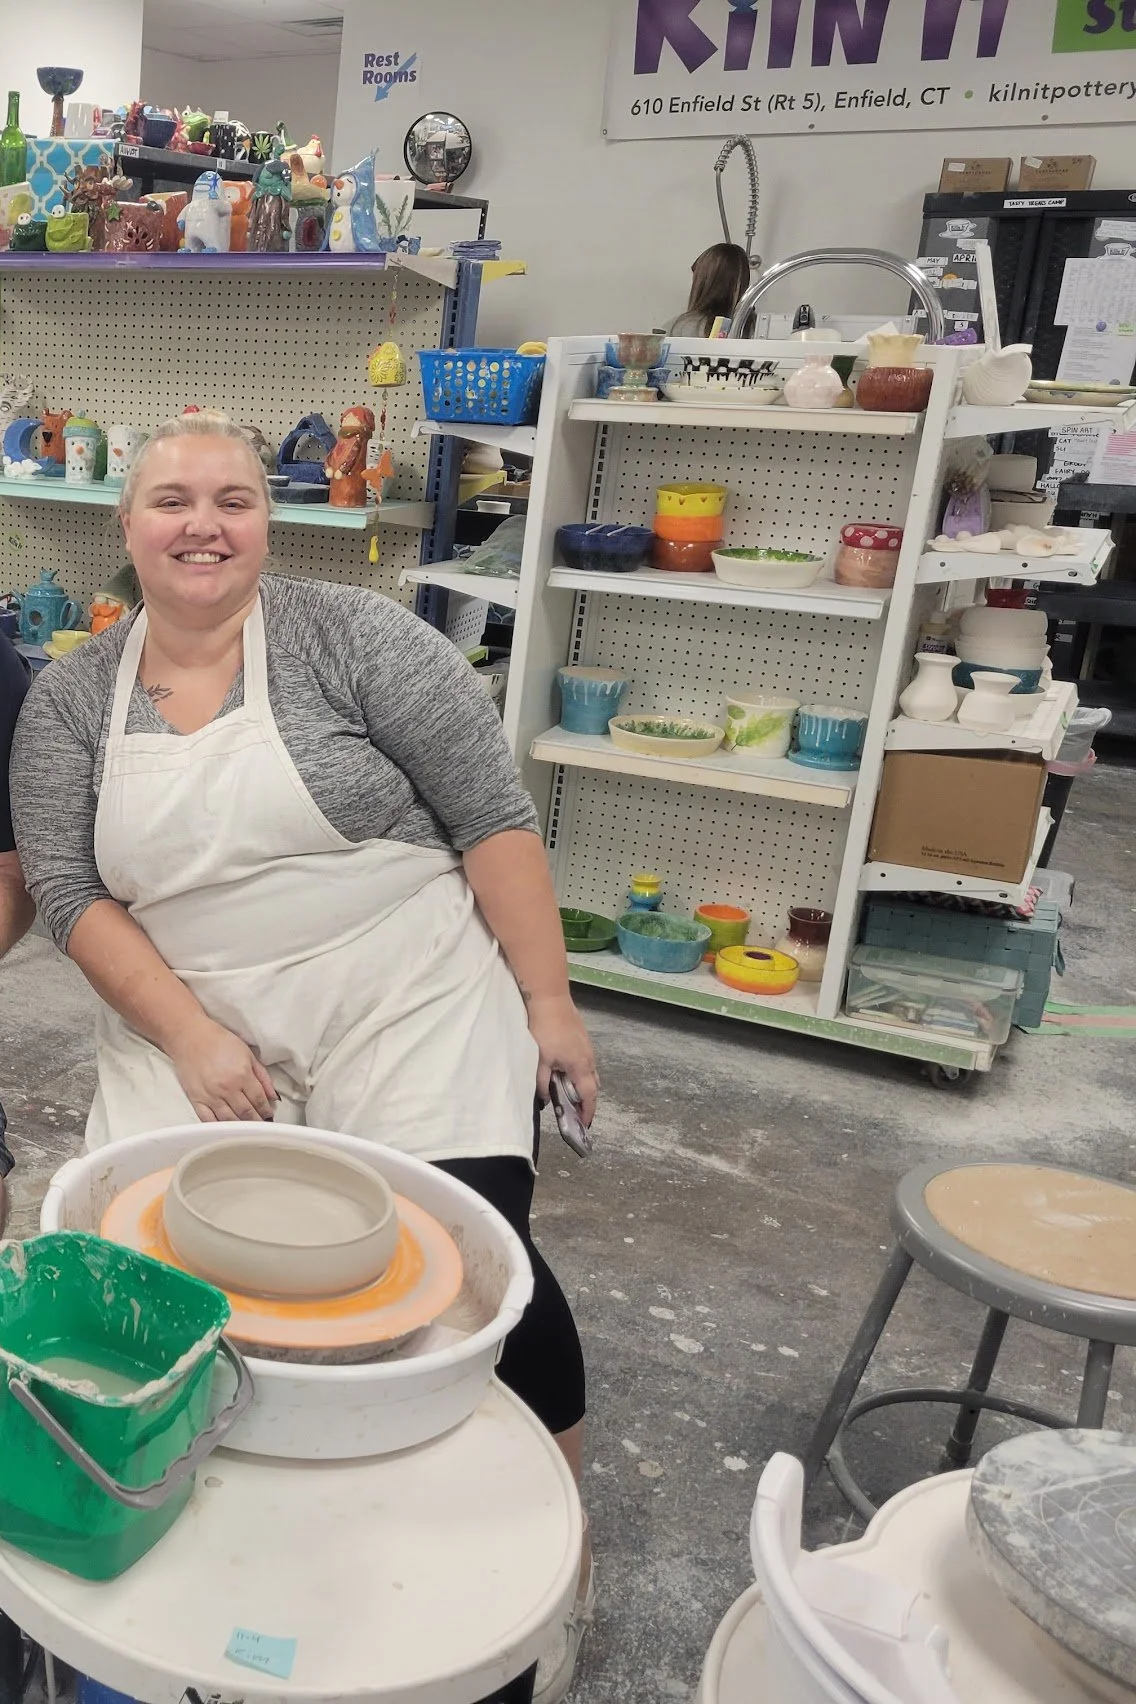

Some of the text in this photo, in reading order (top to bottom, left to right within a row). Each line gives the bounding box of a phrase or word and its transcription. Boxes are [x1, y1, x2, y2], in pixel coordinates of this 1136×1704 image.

[364, 51, 399, 68] Rest
[362, 70, 417, 85] Rooms
[630, 97, 663, 115] 610
[669, 95, 735, 113] Enfield
[740, 95, 762, 112] St
[767, 94, 796, 113] (Rt
[802, 92, 826, 112] 5),
[834, 87, 911, 109] Enfield,
[920, 86, 951, 105] CT
